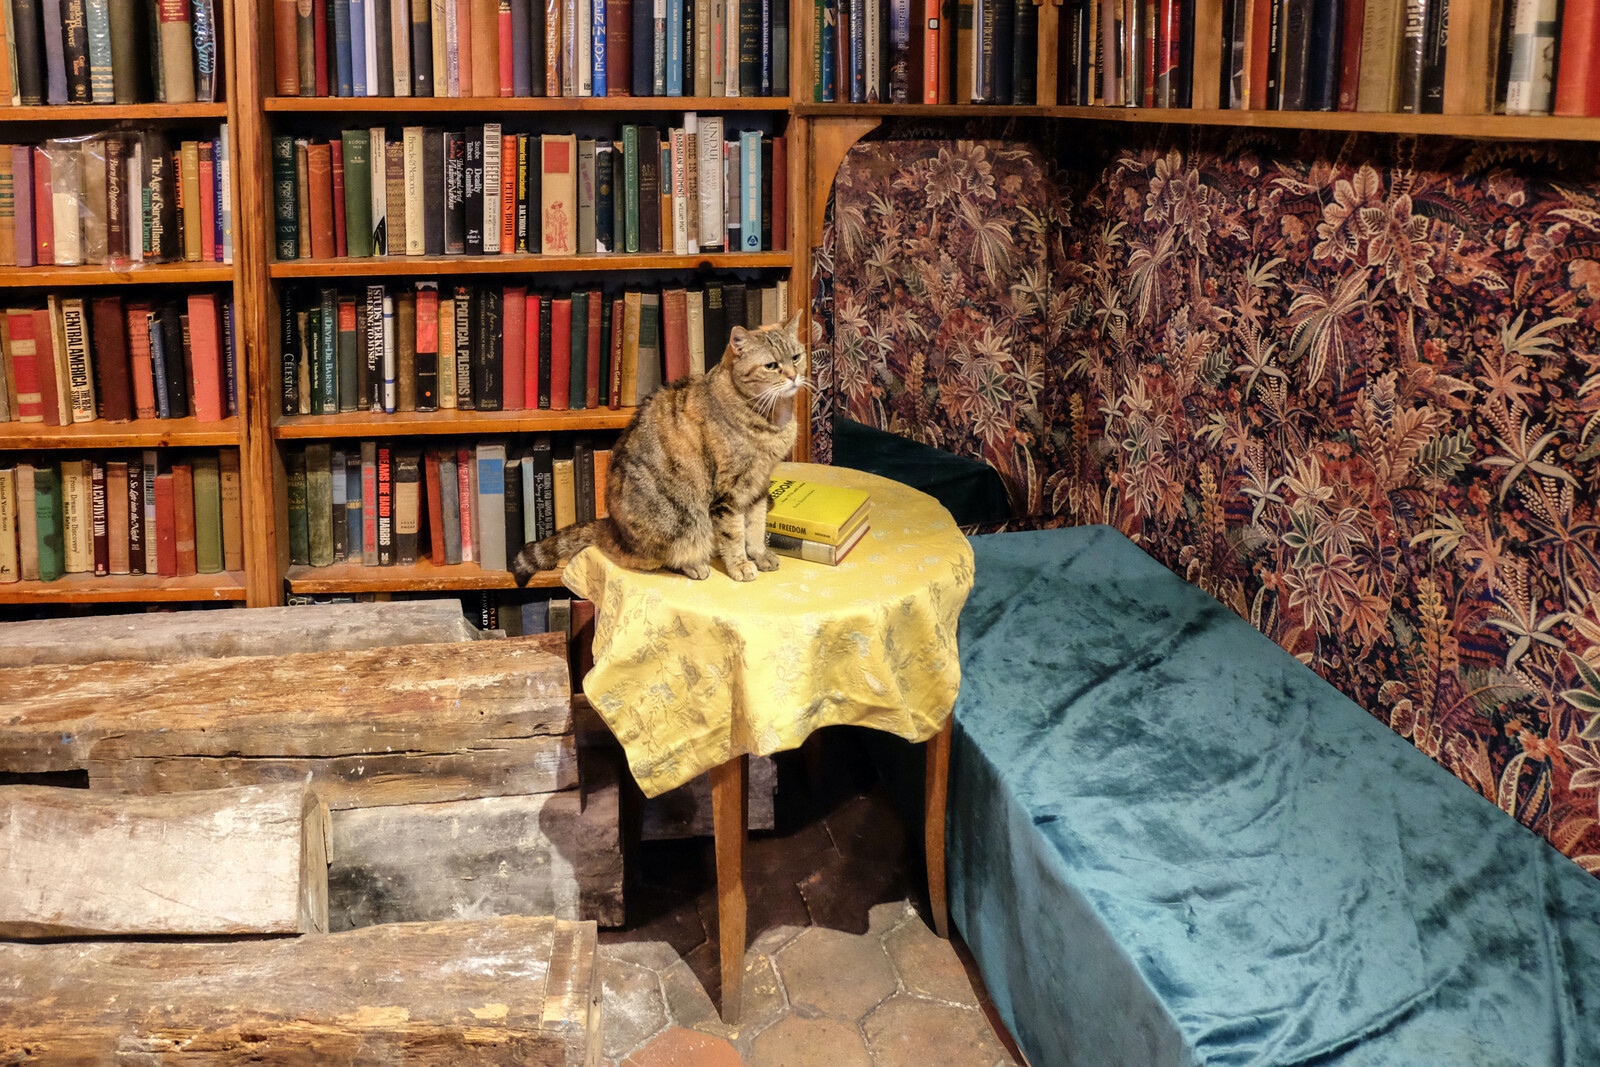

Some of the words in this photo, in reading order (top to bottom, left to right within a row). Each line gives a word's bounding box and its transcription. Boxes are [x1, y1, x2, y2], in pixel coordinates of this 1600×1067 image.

[984, 10, 993, 26] Little
[65, 20, 77, 47] Power
[984, 27, 993, 42] Rich
[195, 37, 214, 74] Sand
[595, 37, 604, 71] LOVE
[486, 124, 500, 132] BY
[408, 136, 416, 158] Friends
[486, 135, 499, 148] WAY
[519, 137, 527, 160] Memories
[676, 134, 685, 164] BARBARIAN
[709, 122, 718, 161] UNDUE
[152, 157, 162, 174] The
[449, 159, 457, 184] Vladimir
[689, 163, 697, 172] IN
[149, 175, 162, 192] Age
[409, 167, 417, 195] Memories
[466, 168, 475, 197] Gambits
[473, 168, 483, 193] Deadly
[486, 162, 499, 196] DECEPTION
[519, 166, 527, 200] Hallucinations
[677, 168, 685, 198] SENTIMENTS
[143, 188, 151, 211] Frank
[152, 193, 163, 202] of
[504, 182, 513, 210] PETRUS
[143, 221, 151, 251] Donner
[151, 203, 163, 251] Surveillance
[505, 213, 513, 236] BOREL
[366, 290, 375, 326] TALKING
[373, 290, 383, 320] STUDS
[489, 292, 498, 309] Love
[65, 311, 83, 347] CENTRAL
[325, 319, 333, 346] DEVIL
[367, 327, 375, 338] TO
[456, 302, 469, 347] POLITICAL
[487, 312, 497, 330] from
[373, 320, 384, 359] TERKEL
[487, 335, 496, 361] Nancy
[325, 349, 333, 364] DR.
[367, 338, 375, 371] MYSELF
[284, 353, 295, 398] CÉLESTINE
[325, 365, 334, 395] BARNES
[457, 351, 470, 395] PILGRIMS
[71, 391, 81, 410] STAKES
[80, 390, 90, 399] THE
[379, 449, 390, 481] DREAMS
[534, 473, 544, 482] The
[130, 480, 138, 488] So
[379, 482, 390, 494] DIE
[458, 463, 469, 508] WEATHERING
[535, 483, 543, 497] Story
[770, 480, 796, 500] EEDOM
[70, 495, 78, 514] Dream
[92, 491, 105, 519] CAPTIVE
[131, 502, 139, 512] into
[379, 496, 390, 516] HARD
[93, 520, 106, 536] LION
[131, 513, 139, 522] the
[779, 523, 807, 535] FREEDOM
[72, 525, 80, 553] Discovery
[130, 522, 140, 541] Night
[380, 518, 391, 545] HARRIS
